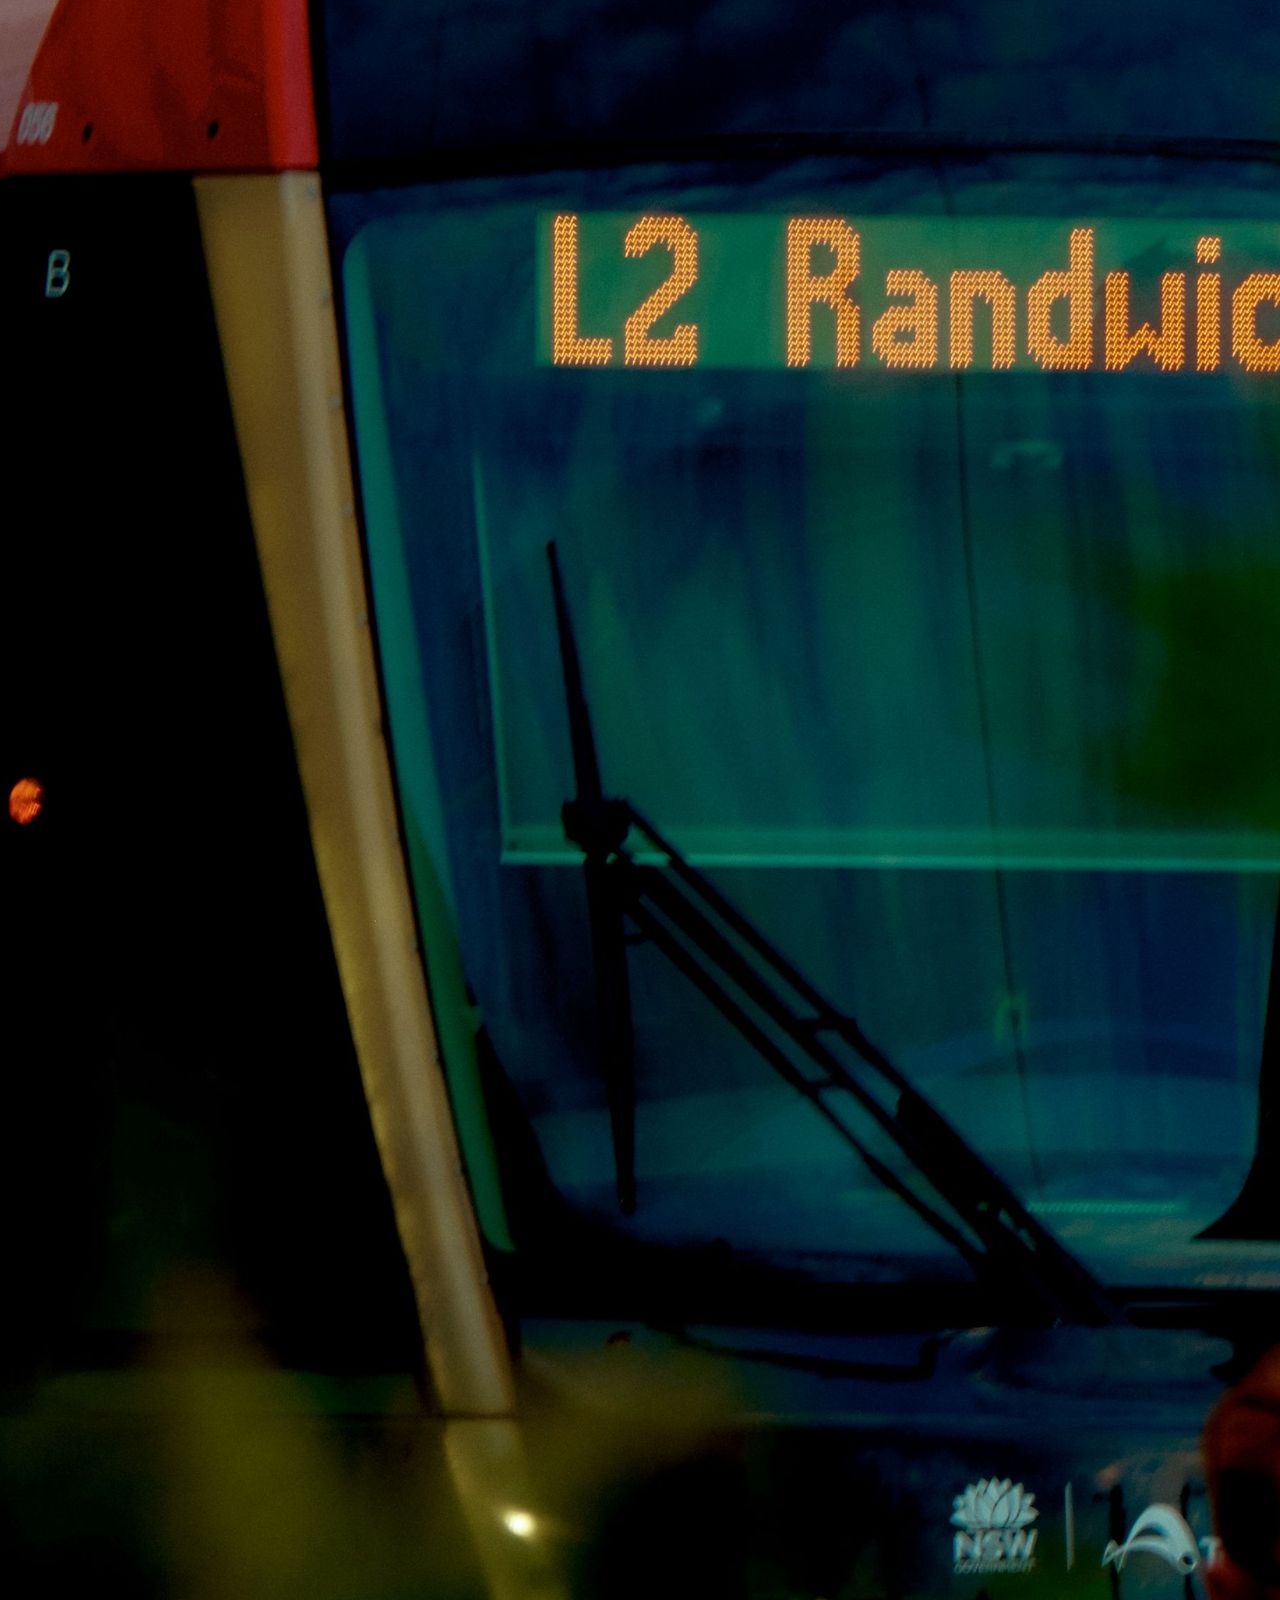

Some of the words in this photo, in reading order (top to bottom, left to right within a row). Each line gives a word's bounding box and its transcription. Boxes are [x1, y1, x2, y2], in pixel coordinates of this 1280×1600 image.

[45, 249, 71, 298] B
[552, 215, 699, 366] L2
[953, 1528, 1038, 1563] NSW
